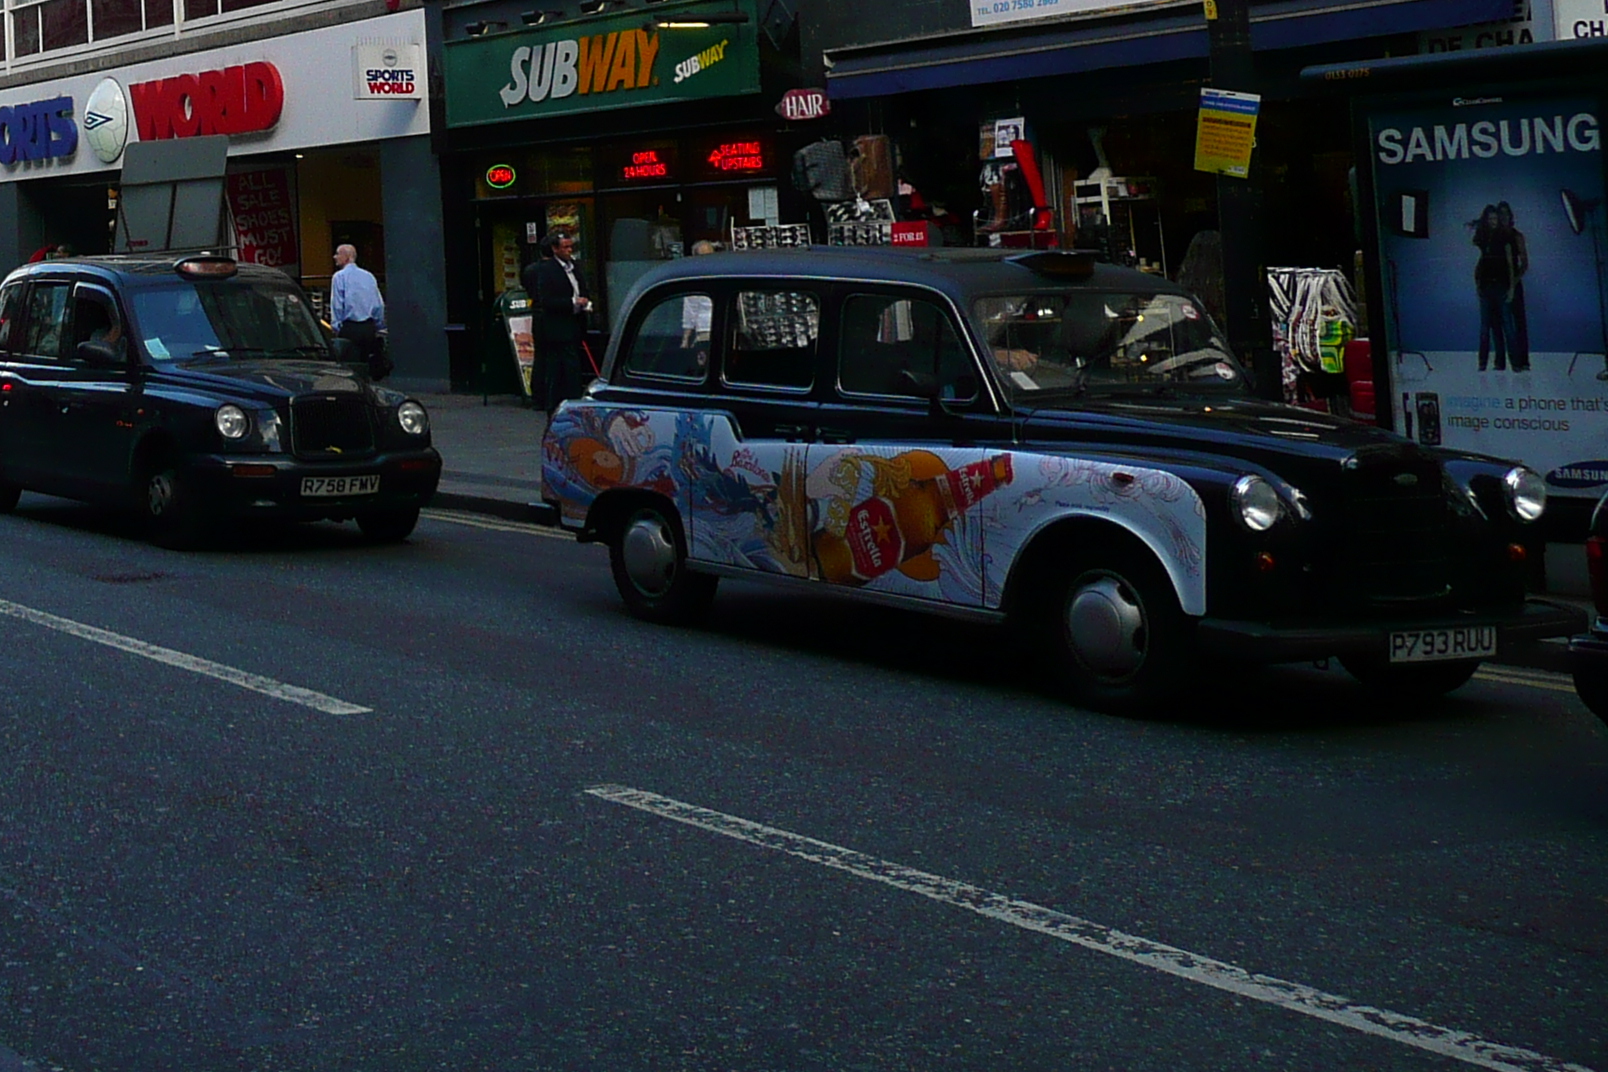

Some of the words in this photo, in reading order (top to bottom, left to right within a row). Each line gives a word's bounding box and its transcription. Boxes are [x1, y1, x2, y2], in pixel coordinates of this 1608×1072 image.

[993, 1, 1009, 13] 020
[499, 27, 660, 109] SUBWAY
[673, 38, 730, 84] SUBWAY
[366, 69, 414, 81] SPORTS
[368, 82, 414, 94] WORLD
[129, 60, 284, 141] WORLD
[786, 93, 824, 117] HAIR
[1378, 113, 1601, 164] SAMSUNG
[721, 141, 760, 156] SEATING
[632, 151, 658, 165] OPEN
[721, 156, 762, 171] UPSTAIRS
[490, 169, 512, 182] OPEN
[623, 167, 636, 179] 24
[637, 163, 667, 178] HOURS
[239, 174, 275, 191] ALL
[237, 190, 281, 210] SALE
[236, 206, 290, 227] SHOES
[241, 227, 289, 249] MUST
[893, 235, 899, 243] 2
[900, 232, 915, 242] FOR
[254, 247, 282, 266] GO!
[1447, 395, 1500, 411] imagine
[1505, 398, 1514, 408] a
[1519, 395, 1566, 412] phone
[1448, 416, 1489, 431] image
[1494, 416, 1569, 431] conscious
[304, 478, 344, 493] R758
[349, 476, 378, 491] FMV
[857, 509, 882, 568] Estrella
[1392, 632, 1448, 657] P793
[1453, 629, 1492, 653] RUU
